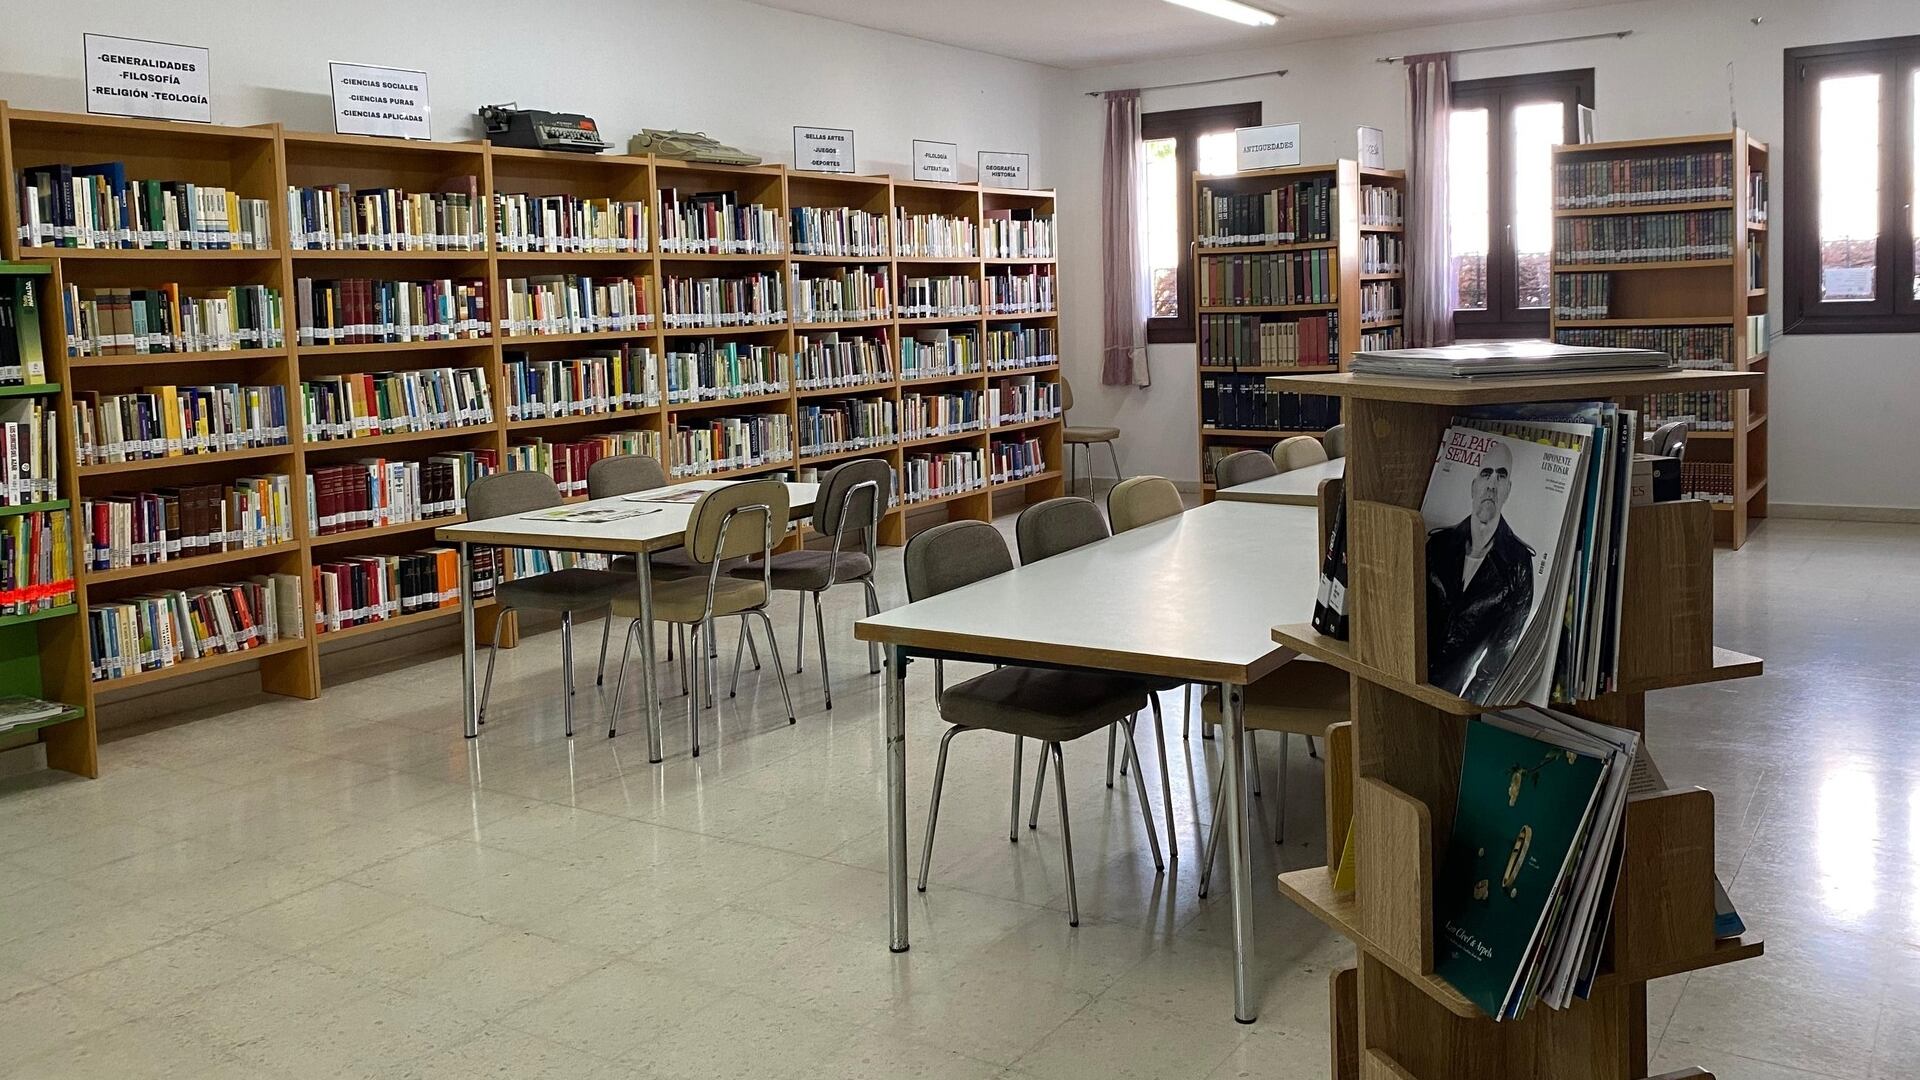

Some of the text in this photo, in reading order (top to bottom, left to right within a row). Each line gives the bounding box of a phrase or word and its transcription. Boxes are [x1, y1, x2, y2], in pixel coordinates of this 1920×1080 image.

[98, 54, 196, 72] -GENERALIDADES
[119, 71, 180, 85] -FILOSOFÍA
[341, 78, 418, 91] -CIENCIAS SOCIALES
[92, 86, 208, 104] -RELIGIÓN -TEOLOGÍA
[349, 95, 414, 106] -CIENCIAS PURAS
[341, 110, 423, 122] -CIENCIAS APLICADAS
[1451, 432, 1466, 447] EL
[1445, 447, 1484, 467] SEMA
[1543, 452, 1572, 466] IMPONENTE
[1541, 461, 1569, 476] LUIS TOSAR
